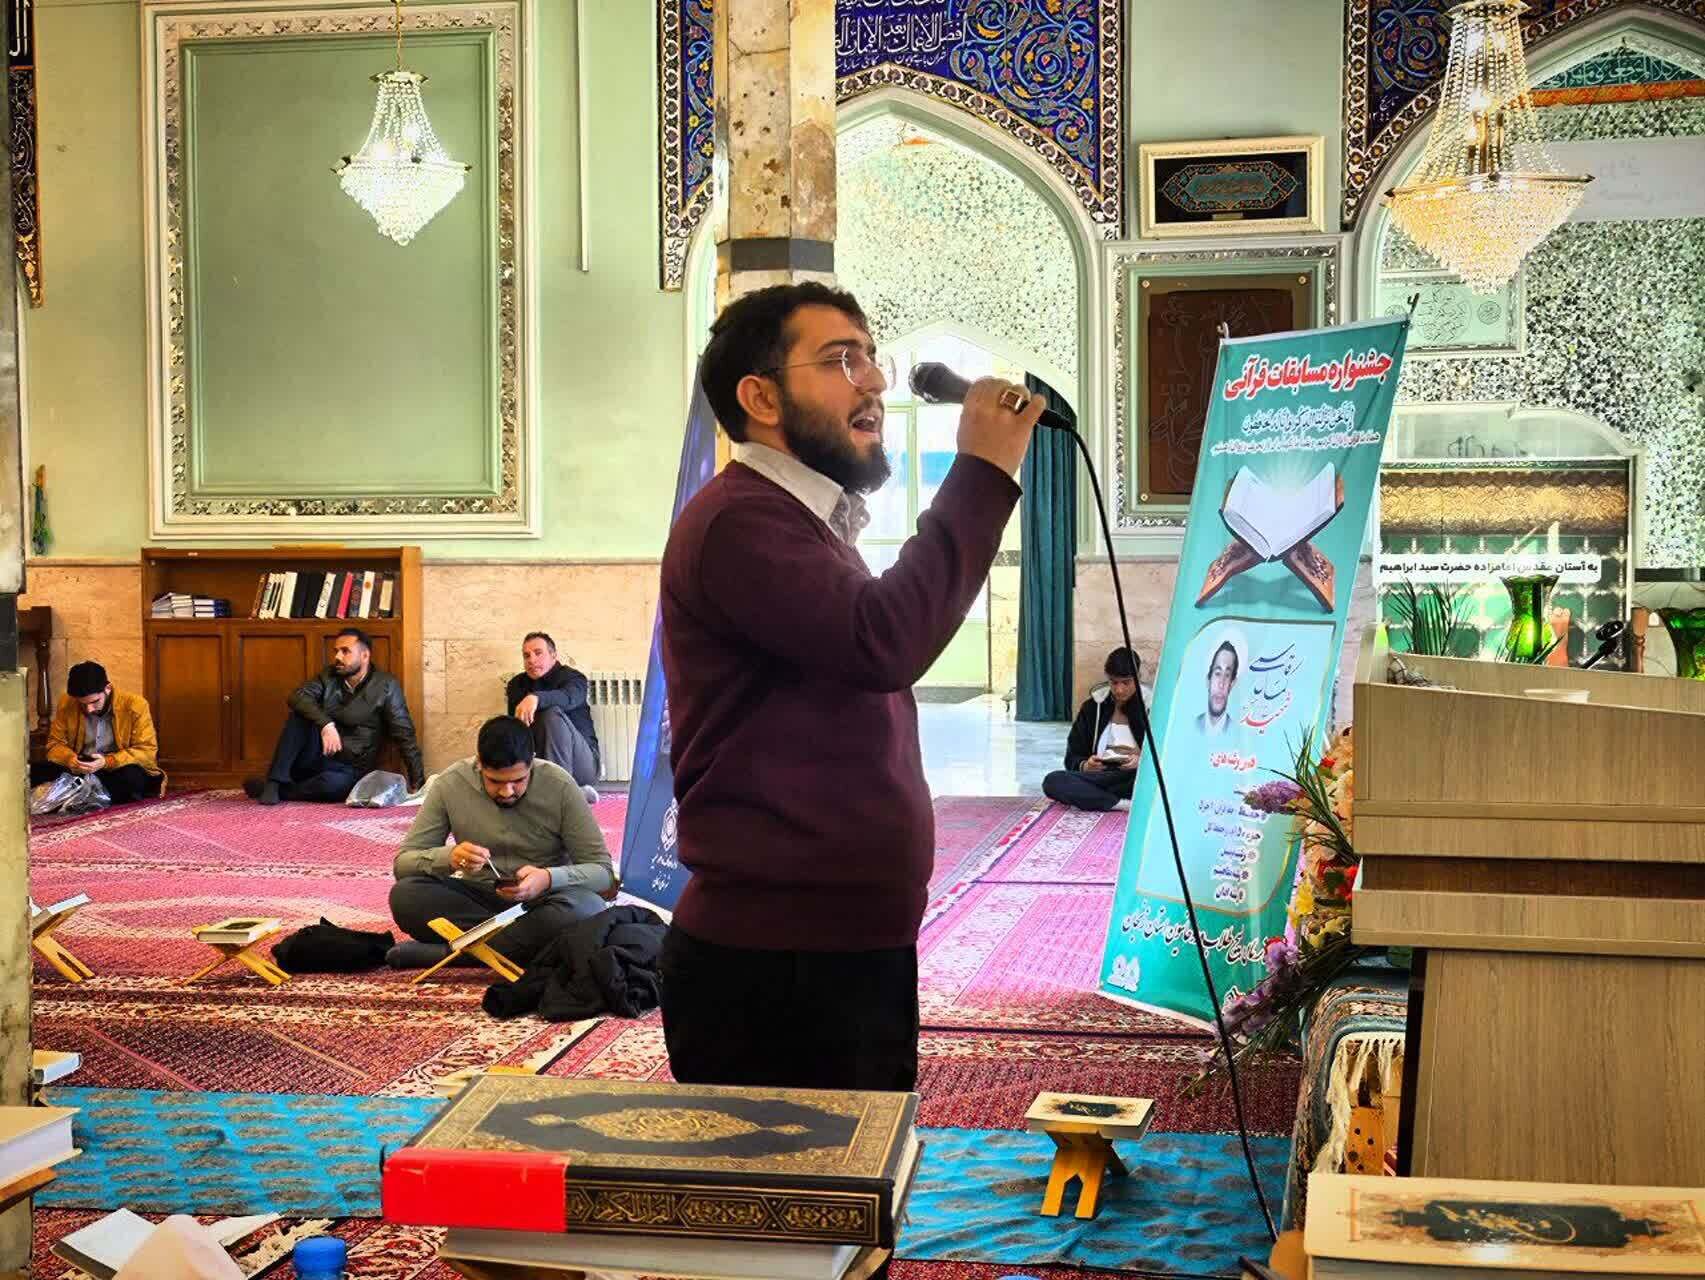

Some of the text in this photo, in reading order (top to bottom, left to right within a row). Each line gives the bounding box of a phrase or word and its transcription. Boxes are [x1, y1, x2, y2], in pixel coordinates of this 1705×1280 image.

[1223, 349, 1393, 400] جشنواره مسابقات قرآنی
[1379, 562, 1417, 574] ابراهیم
[1418, 562, 1439, 575] سید
[1440, 562, 1472, 575] حضرت
[1555, 560, 1586, 574] آستان
[1586, 562, 1599, 574] به
